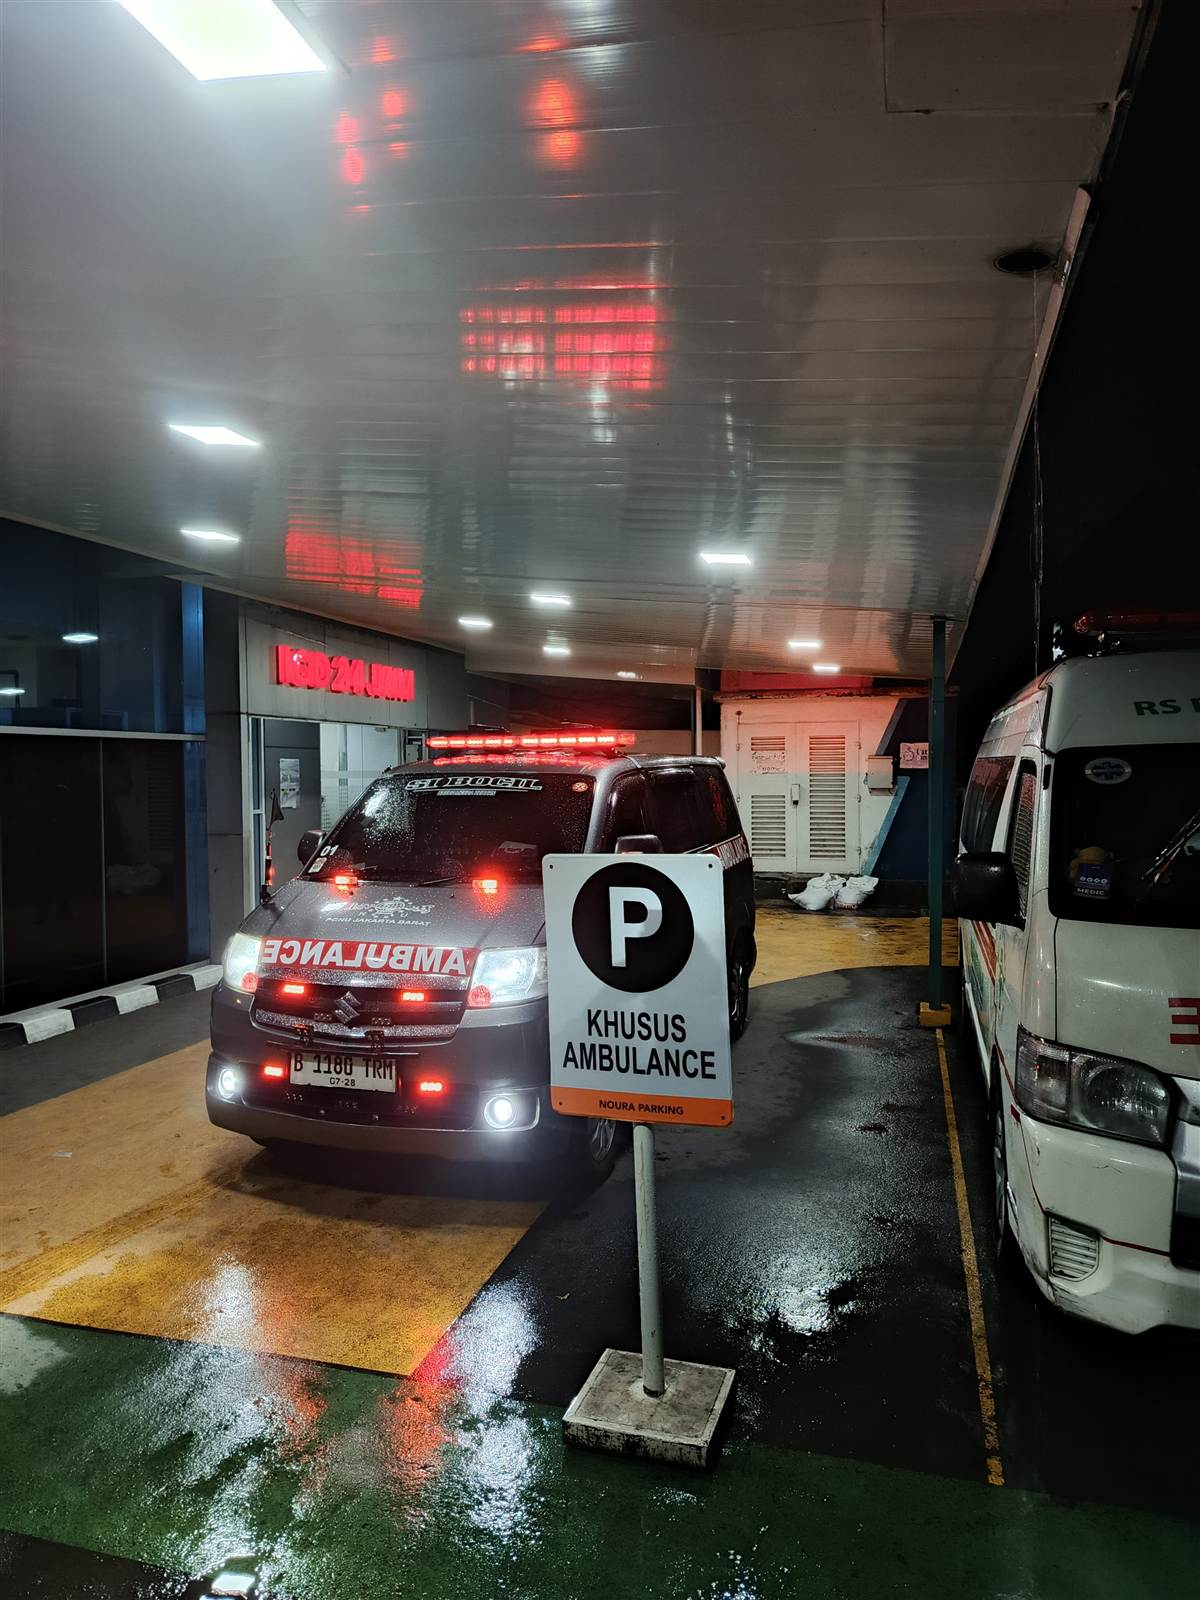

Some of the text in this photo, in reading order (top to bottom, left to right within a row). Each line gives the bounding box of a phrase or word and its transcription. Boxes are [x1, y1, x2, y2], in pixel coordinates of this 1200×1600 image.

[331, 655, 365, 695] 24
[1134, 699, 1182, 716] RS
[320, 845, 339, 856] 01
[608, 886, 663, 967] P
[587, 1009, 686, 1043] KHUSUS
[294, 1053, 303, 1072] B
[362, 1057, 394, 1080] TRM
[562, 1041, 717, 1080] AMBULANCE
[599, 1099, 684, 1116] NOURA PARKING
